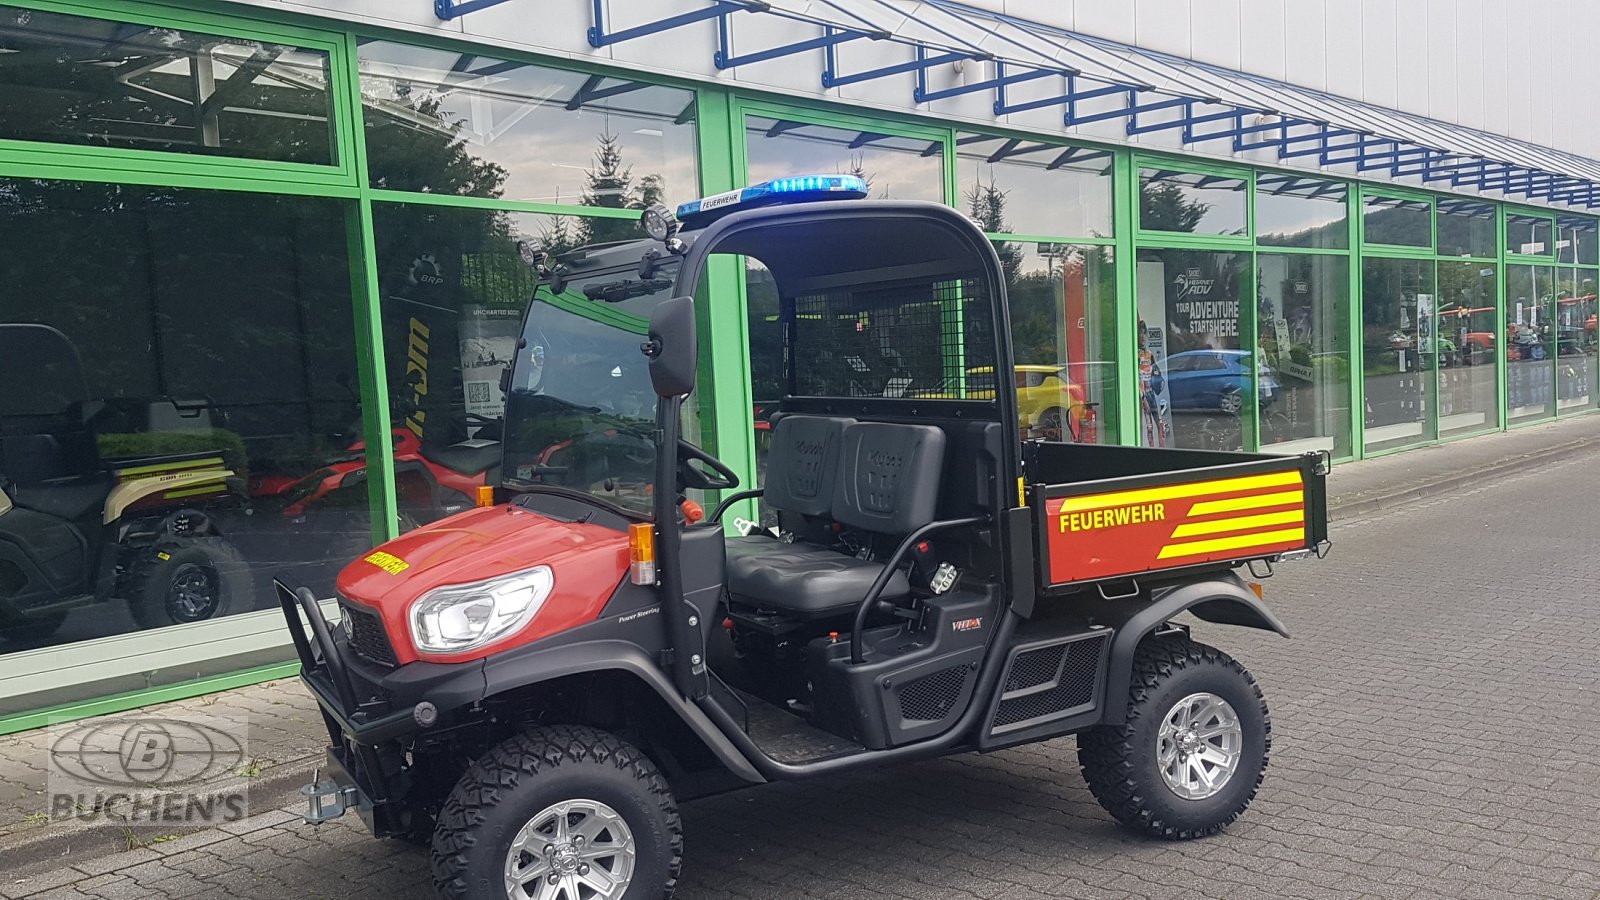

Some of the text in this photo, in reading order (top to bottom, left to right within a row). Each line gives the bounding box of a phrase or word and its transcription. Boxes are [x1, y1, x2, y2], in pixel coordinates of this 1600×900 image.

[702, 194, 738, 209] FEUERWEHR
[420, 274, 444, 285] BRP
[1188, 285, 1212, 294] ADV
[1176, 300, 1239, 319] YOUR ADVENTURE
[1190, 319, 1239, 337] STARTS HERE.
[1060, 503, 1165, 533] FEUERWEHR
[364, 551, 410, 576] FEUERWEHR
[618, 607, 660, 623] Power Steering
